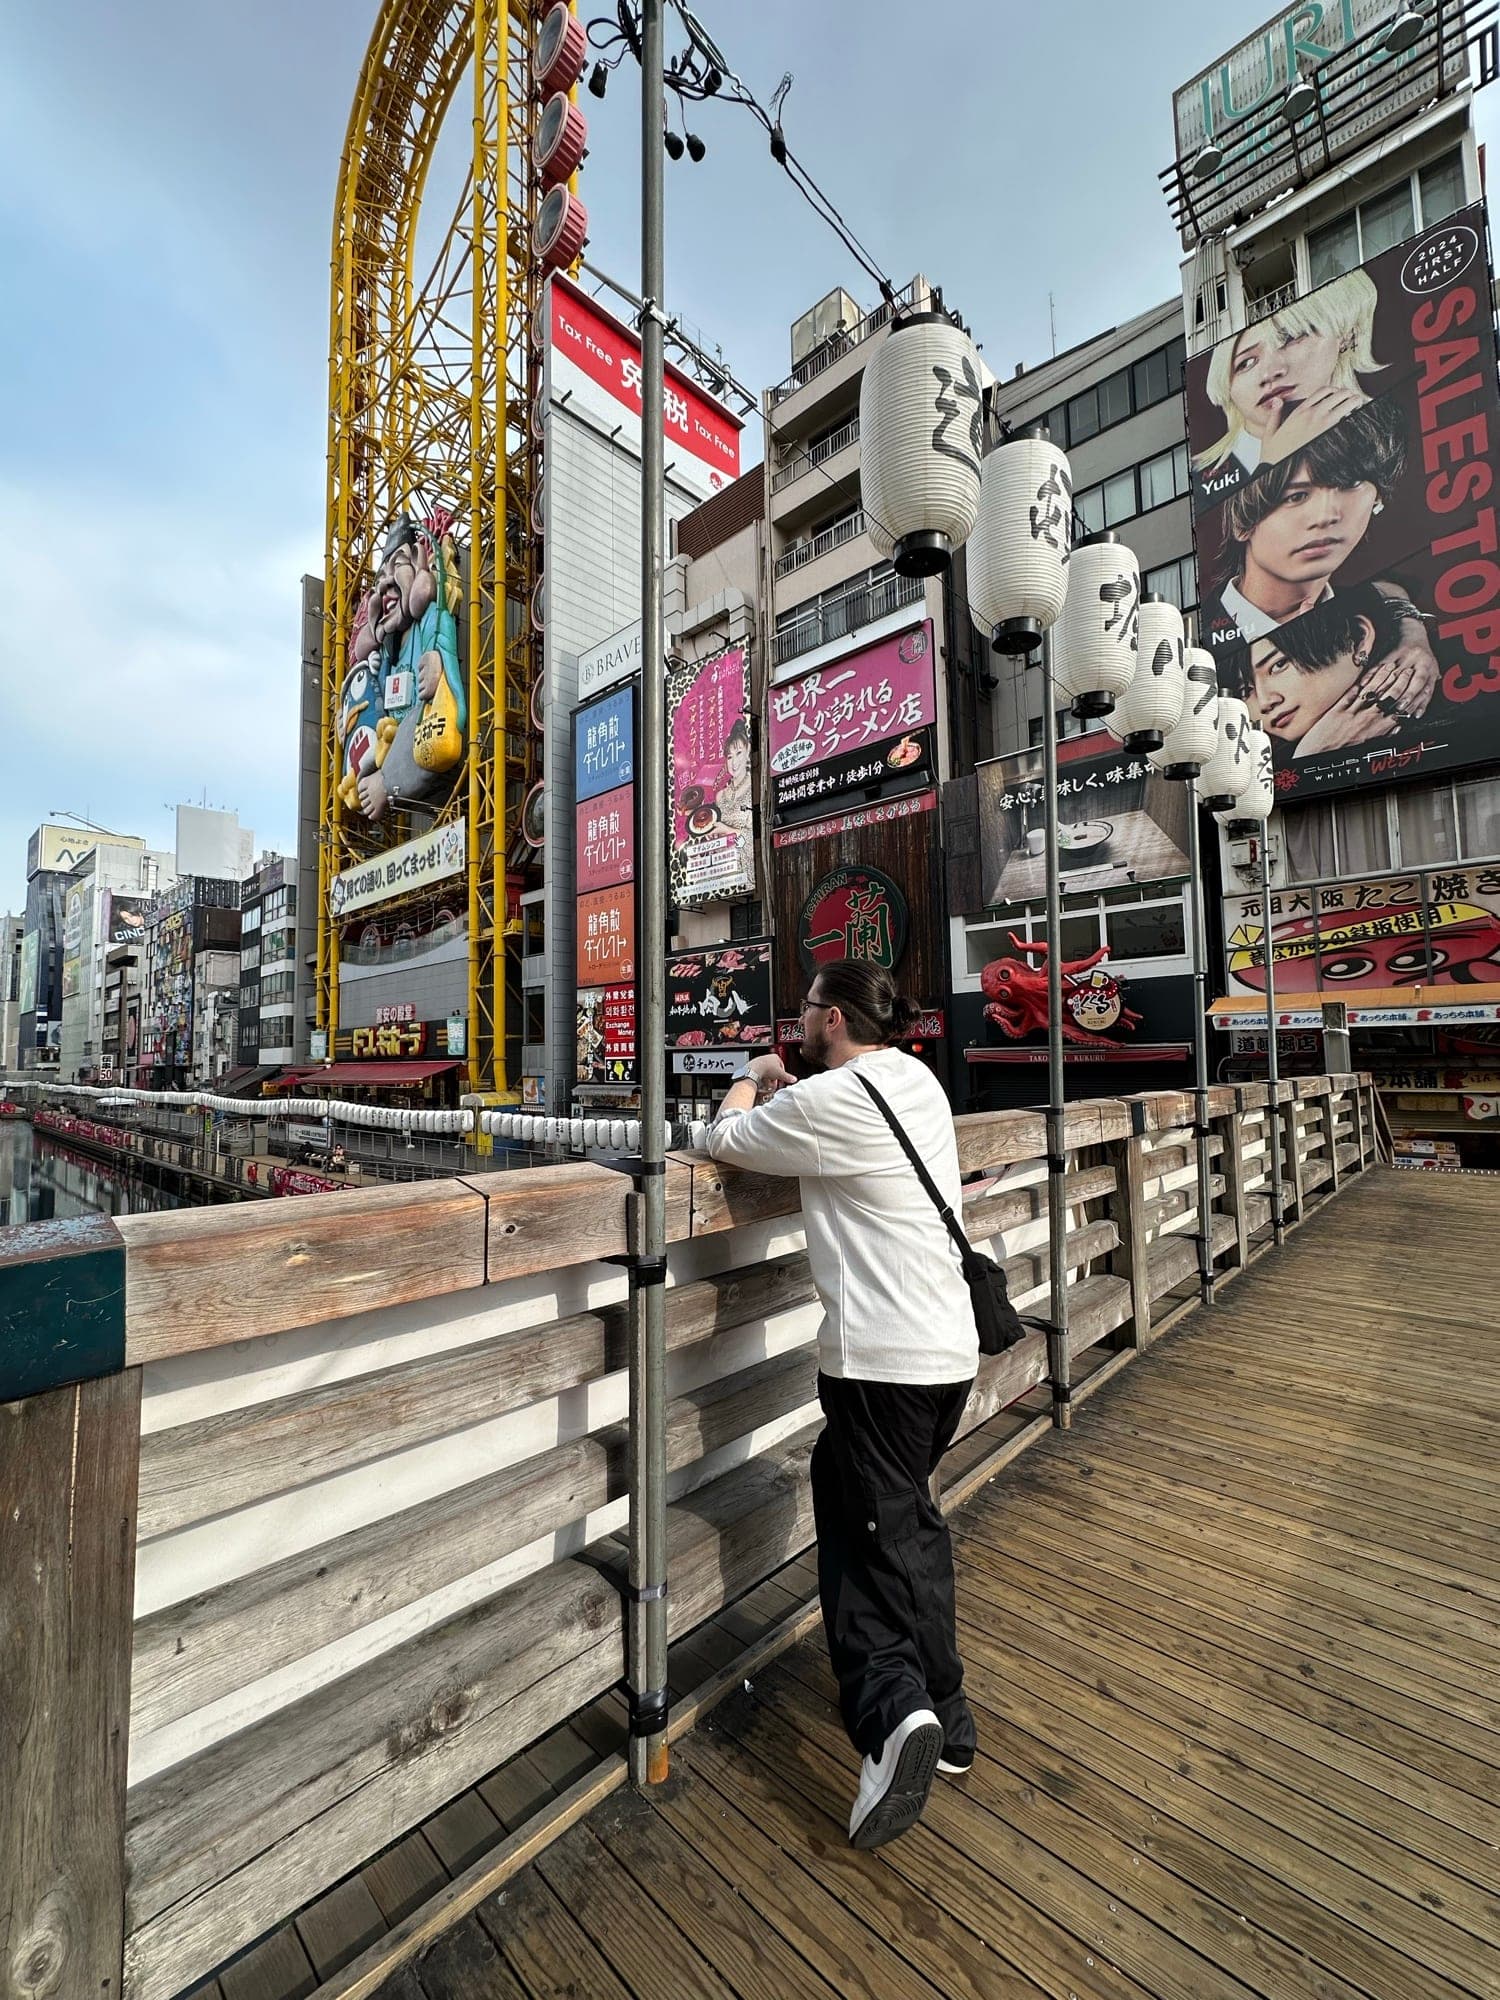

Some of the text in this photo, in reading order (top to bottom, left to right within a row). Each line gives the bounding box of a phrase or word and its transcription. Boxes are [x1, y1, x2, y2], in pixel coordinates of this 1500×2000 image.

[1414, 243, 1464, 276] FIRST
[1418, 235, 1457, 262] 2024
[1418, 257, 1462, 286] HALF
[558, 315, 614, 367] Tax Free
[694, 419, 736, 459] Tax Free
[1201, 469, 1240, 494] Yuki
[597, 634, 641, 676] BRAVE
[772, 670, 856, 722] 世界一
[794, 678, 893, 740] 人が訪れる
[587, 715, 619, 750] 龍角散
[821, 692, 923, 757] ラーメン店
[583, 740, 625, 775] ダイレクト
[1304, 758, 1359, 774] CLUB
[1315, 766, 1361, 782] WHITE
[587, 810, 619, 842] 龍角散
[583, 836, 626, 868] ダイレクト
[803, 873, 848, 921] ICHIRAN
[588, 907, 620, 937] 龍角散
[803, 881, 894, 969] 一蘭
[584, 935, 627, 962] ダイレクト
